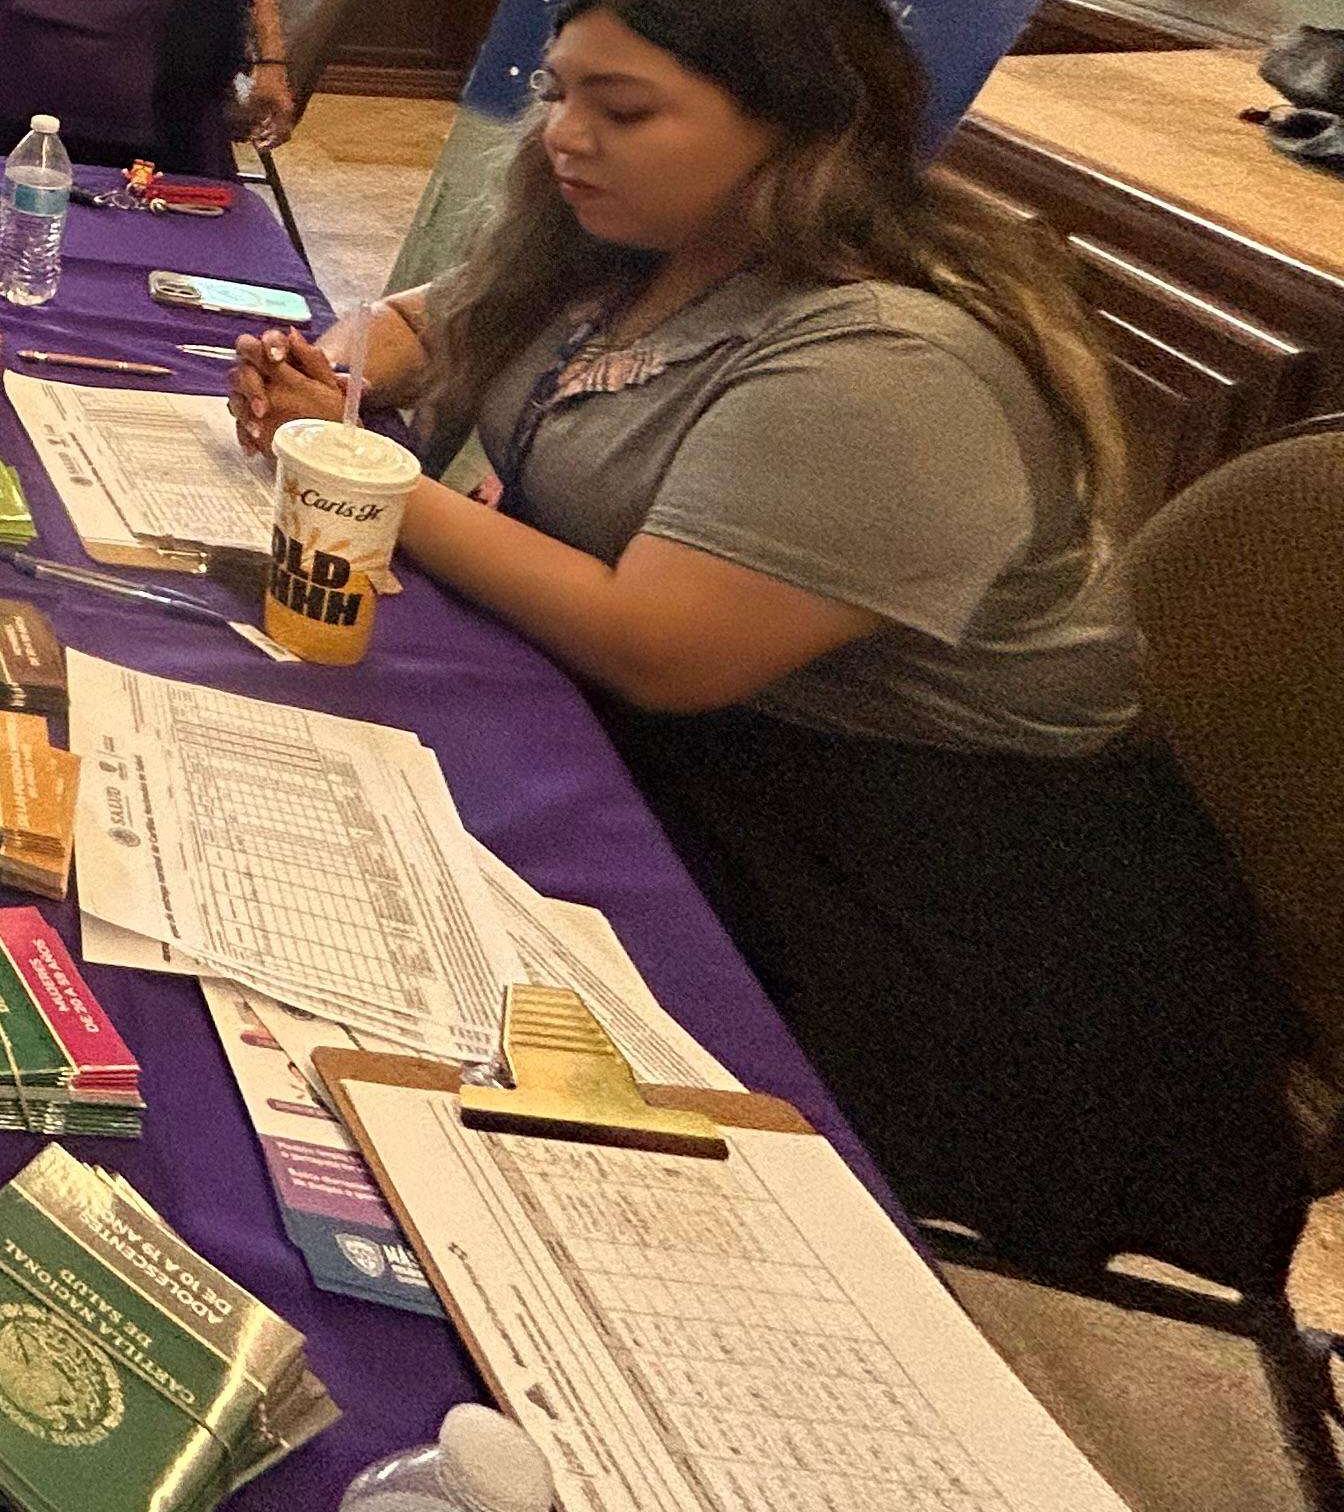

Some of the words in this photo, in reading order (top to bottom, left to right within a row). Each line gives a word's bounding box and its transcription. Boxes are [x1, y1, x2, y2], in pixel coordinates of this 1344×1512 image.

[141, 1241, 164, 1262] 19
[164, 1258, 180, 1272] A
[4, 1239, 97, 1323] NACIONAL
[80, 1209, 225, 1325] ADOLESCENTES
[59, 1268, 124, 1323] SALUD
[178, 1271, 203, 1293] 10
[201, 1290, 233, 1316] DE
[123, 1321, 153, 1349] DE
[99, 1320, 196, 1405] CARTILLA
